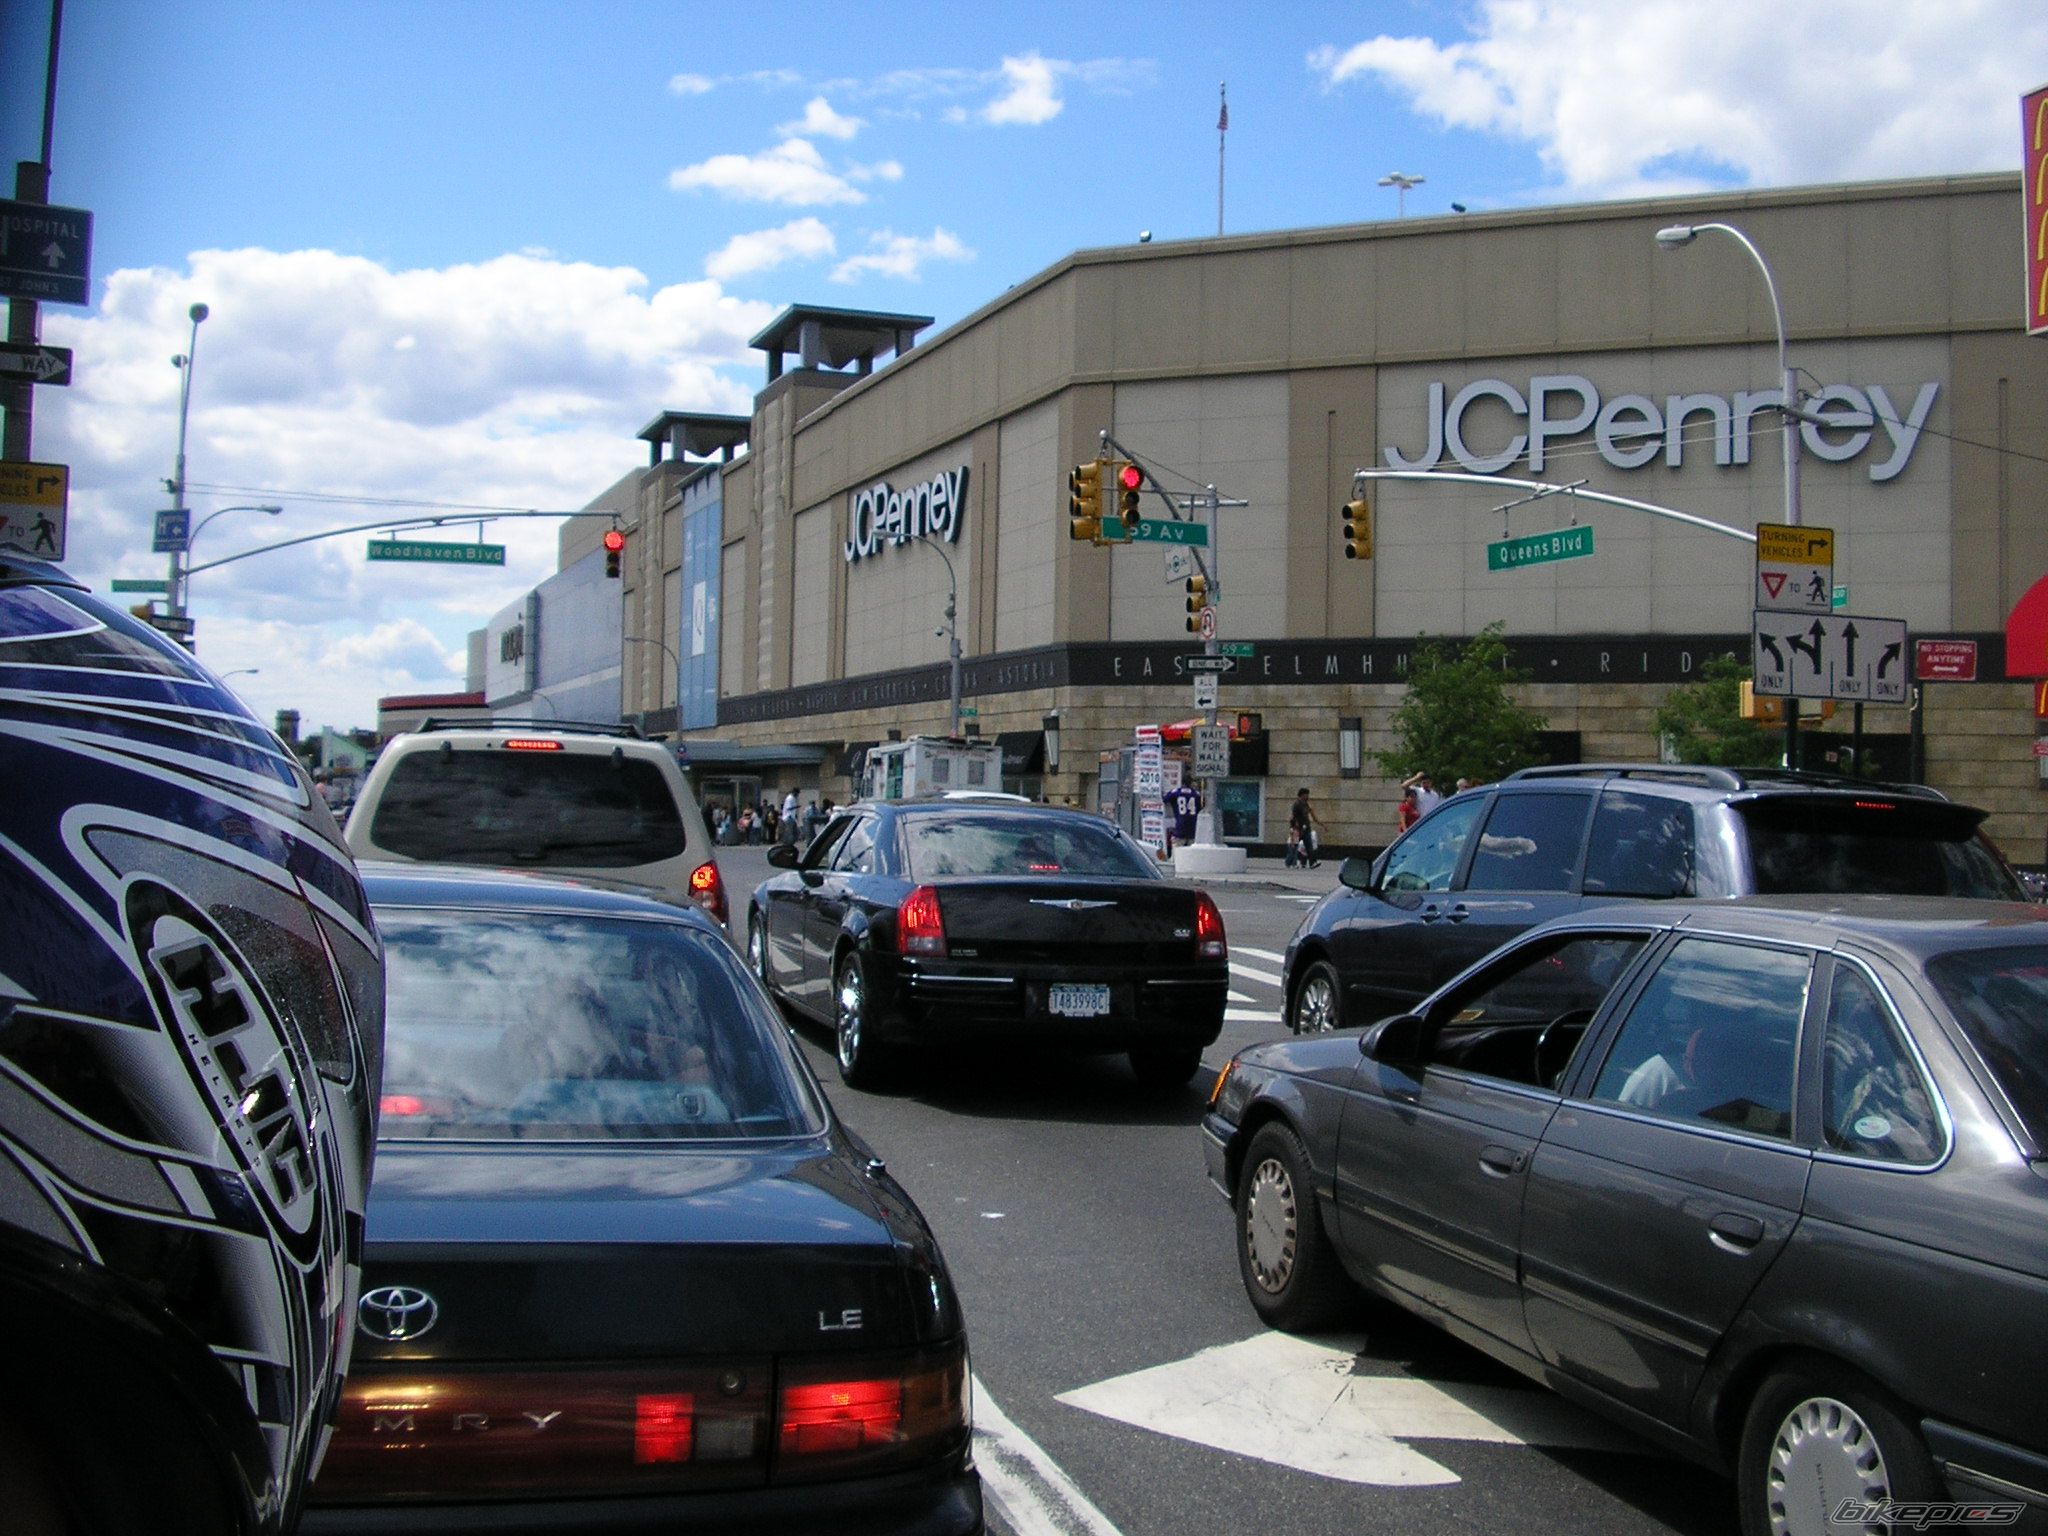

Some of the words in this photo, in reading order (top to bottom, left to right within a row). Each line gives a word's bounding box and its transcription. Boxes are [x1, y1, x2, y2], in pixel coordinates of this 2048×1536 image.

[23, 353, 58, 373] WAY
[1384, 376, 1940, 482] JCPenney
[844, 466, 966, 562] JCPenney
[9, 526, 26, 537] TO
[1159, 524, 1184, 541] Av
[1761, 531, 1806, 545] TURNING
[371, 544, 462, 560] Woodhaven
[466, 547, 502, 561] Blvd
[1500, 542, 1549, 563] Queens
[1552, 534, 1583, 555] Blvd
[1760, 546, 1804, 559] VEHICLES
[1788, 582, 1802, 593] TO
[1222, 644, 1236, 654] 59
[1920, 644, 1931, 652] NO
[1935, 644, 1973, 653] STOPPING
[1114, 656, 1183, 677] EAS
[1214, 659, 1230, 668] WAY
[1927, 655, 1966, 664] ANYTIME
[1760, 675, 1784, 689] ONLY
[1839, 679, 1862, 693] ONLY
[1877, 682, 1900, 696] ONLY
[1200, 731, 1222, 739] WAIT
[1203, 742, 1221, 751] FOR
[1199, 753, 1225, 762] WALK
[1196, 764, 1225, 773] SIGNAL
[1140, 772, 1160, 784] 2010
[1177, 796, 1197, 815] 84
[152, 937, 316, 1208] HJC
[188, 1033, 263, 1170] HELMETS
[818, 1309, 864, 1331] LE
[373, 1411, 563, 1431] MRY
